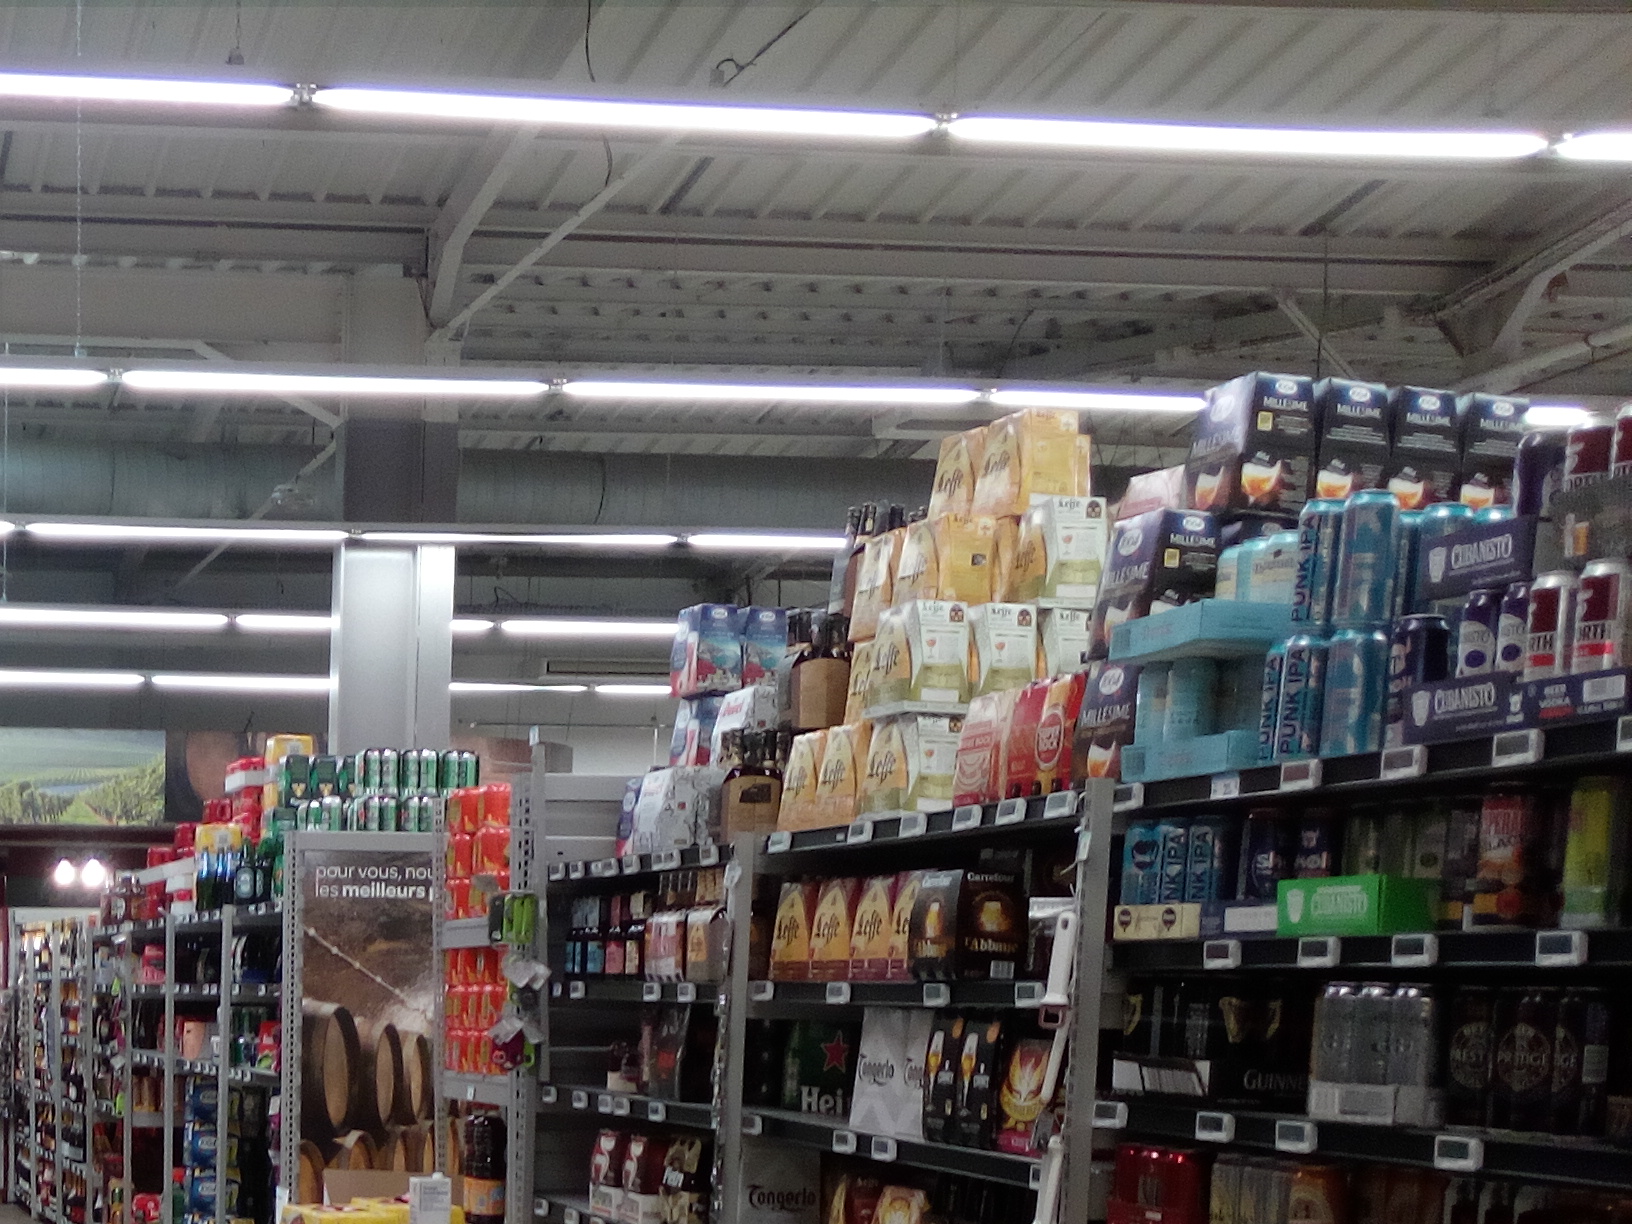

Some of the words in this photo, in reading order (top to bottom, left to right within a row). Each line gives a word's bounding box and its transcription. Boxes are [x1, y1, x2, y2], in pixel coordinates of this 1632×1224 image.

[1300, 514, 1315, 549] IPA
[1451, 533, 1513, 569] CUBANISTO
[1291, 558, 1310, 622] PUNK
[1288, 648, 1306, 684] IPA
[1434, 682, 1496, 714] CUBANISTO
[1280, 688, 1303, 754] PUNK
[821, 758, 848, 793] Leffe
[868, 751, 897, 784] Leffe
[315, 881, 339, 898] les
[342, 881, 427, 899] meilleurs
[316, 866, 356, 884] pour
[358, 865, 402, 882] vous,
[777, 914, 800, 946] Leffe
[815, 911, 841, 945] Leffe
[855, 909, 883, 941] Leffe
